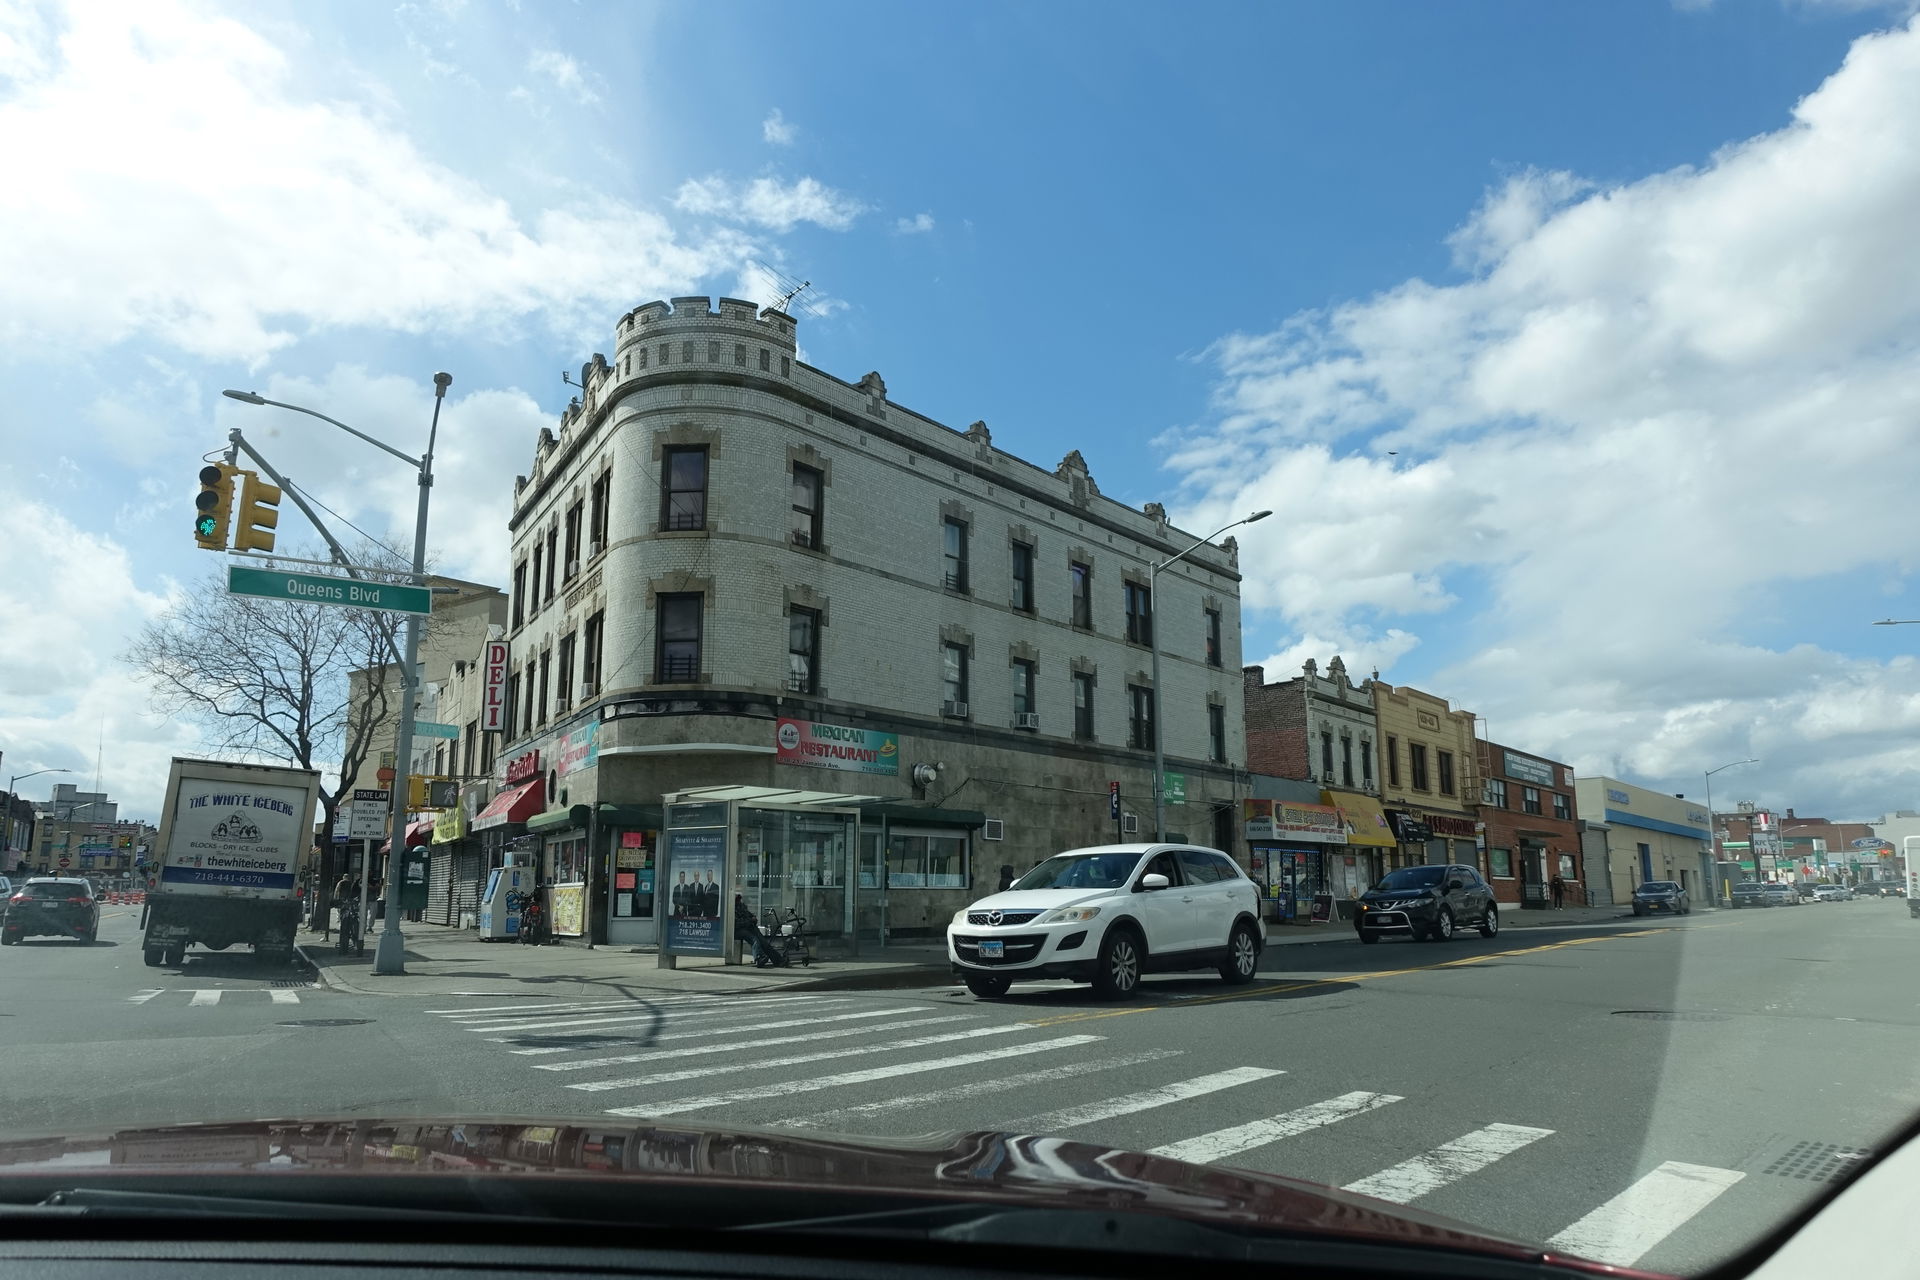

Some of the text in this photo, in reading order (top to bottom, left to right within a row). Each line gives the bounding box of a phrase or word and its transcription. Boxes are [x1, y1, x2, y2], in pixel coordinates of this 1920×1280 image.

[287, 579, 380, 603] Queens Blvd
[488, 645, 506, 726] DELI
[811, 723, 865, 743] MEXICAN
[800, 740, 880, 763] RESTAURANT
[801, 759, 827, 768] Jamaica
[356, 791, 374, 799] STATE
[189, 794, 294, 816] THE WHITE ICEBERG
[190, 841, 217, 849] BLOCKS
[207, 855, 287, 872] thewhiteiceberg
[195, 872, 264, 884] 718-441-6370
[678, 921, 712, 929] 718.291.3400
[679, 928, 688, 936] 718
